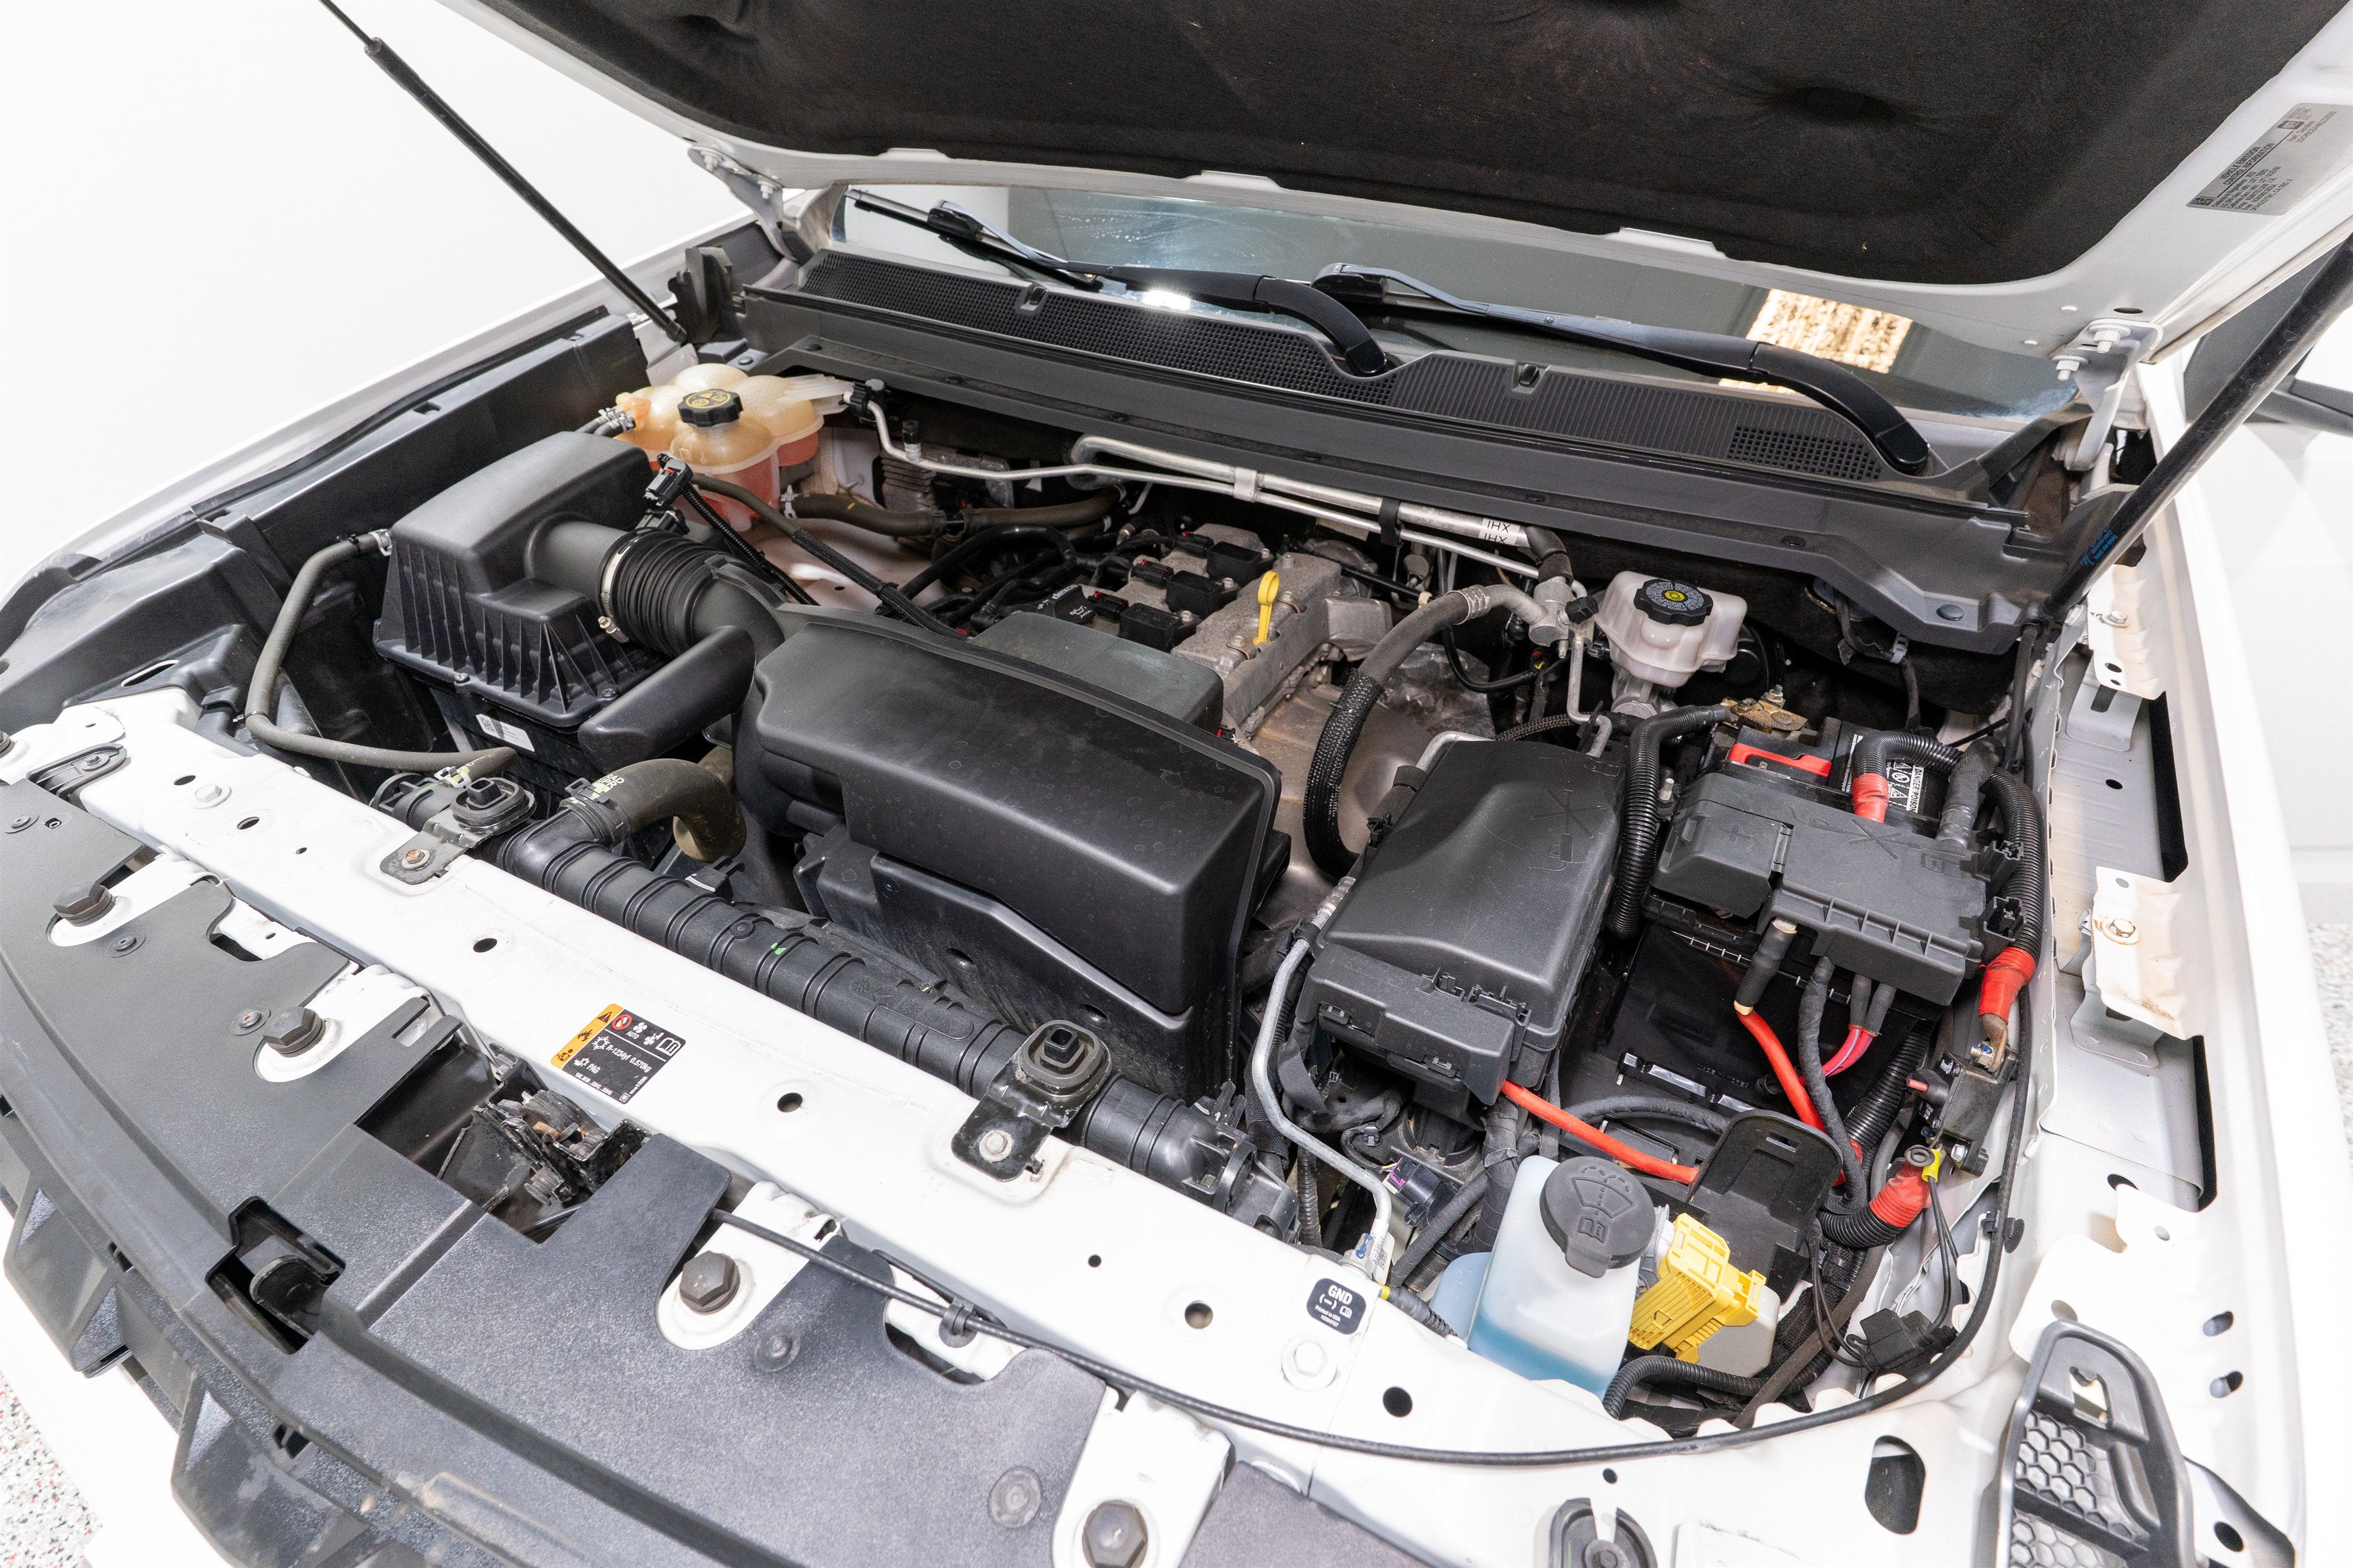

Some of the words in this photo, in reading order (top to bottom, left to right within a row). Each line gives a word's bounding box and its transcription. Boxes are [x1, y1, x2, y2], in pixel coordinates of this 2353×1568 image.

[2220, 164, 2242, 179] VEHICLE
[2236, 146, 2262, 164] EMISSION
[2223, 168, 2248, 184] CONTROL
[2242, 142, 2276, 168] INFORMATION
[1487, 520, 1511, 534] IHX
[626, 1031, 639, 1040] AUTO
[587, 1063, 601, 1074] PAG
[605, 1044, 631, 1060] R-1234yf
[630, 1057, 652, 1072] 0.570kg
[1328, 1284, 1353, 1305] GND
